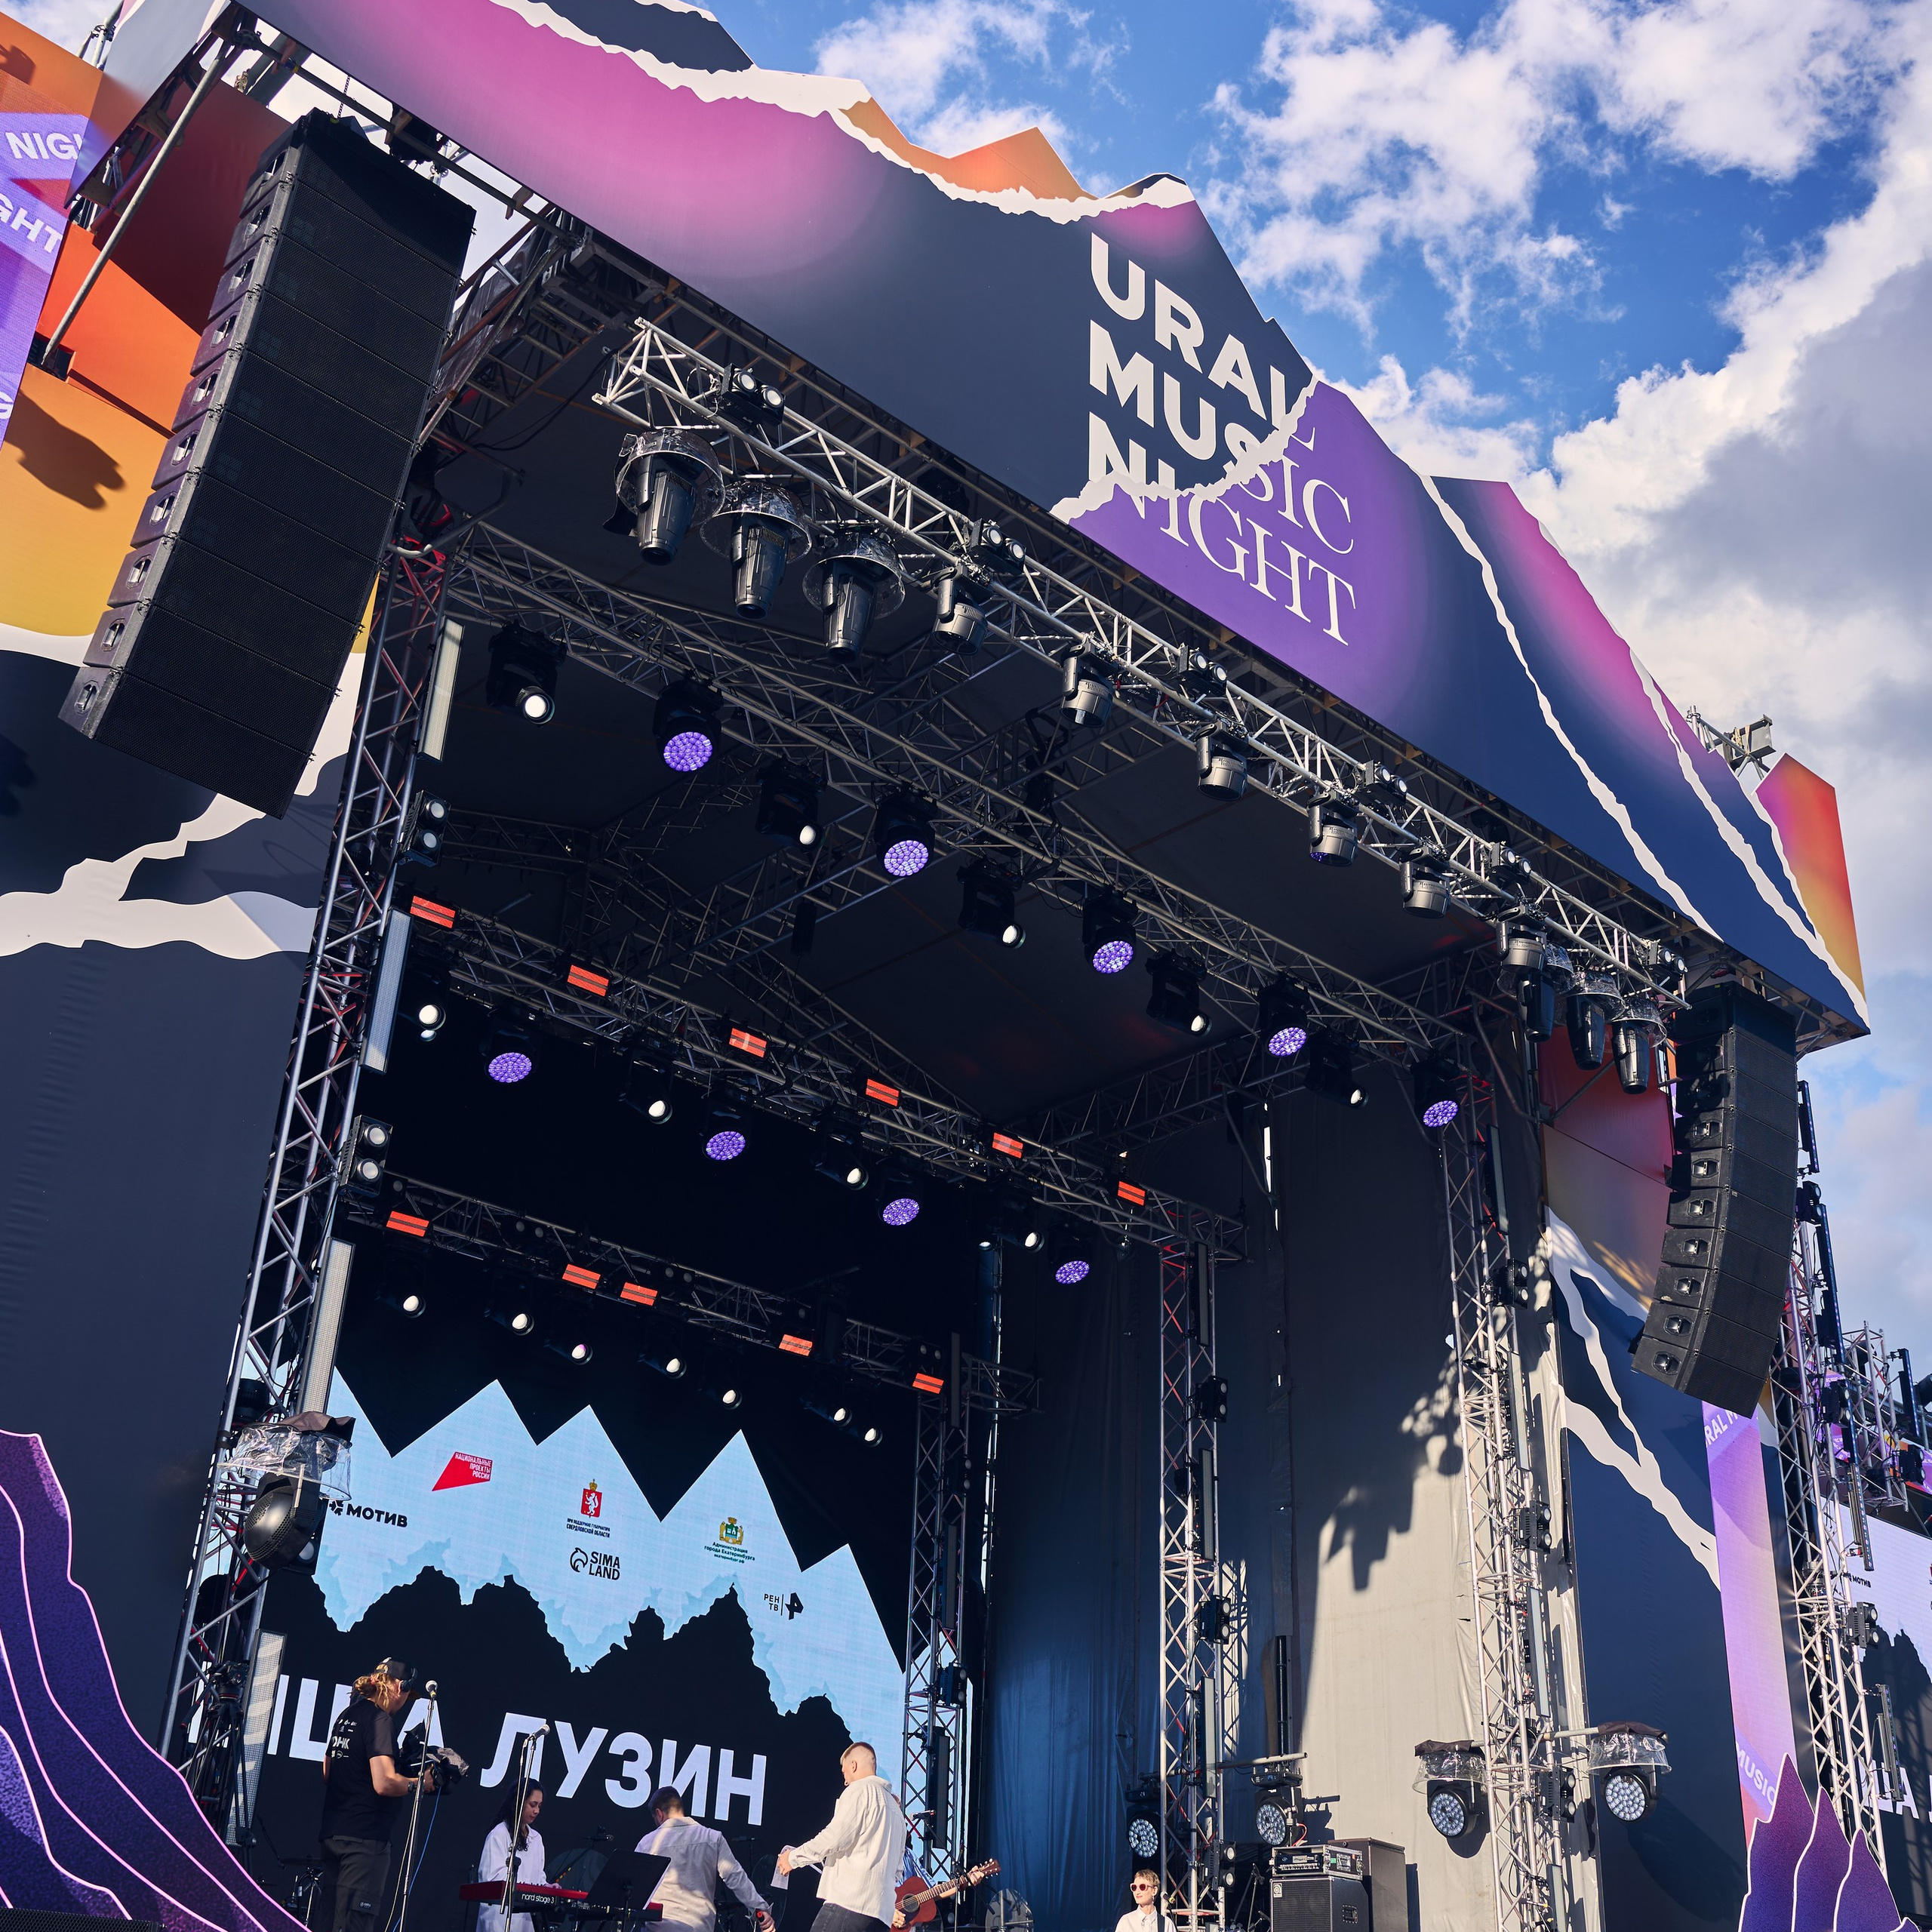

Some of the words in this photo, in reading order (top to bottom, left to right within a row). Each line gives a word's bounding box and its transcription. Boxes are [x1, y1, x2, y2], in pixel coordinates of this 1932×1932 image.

[1091, 232, 1316, 451] URAL
[1089, 318, 1355, 555] MUSIC
[1088, 411, 1356, 647] NIGHT
[1704, 1414, 1728, 1448] RAL
[469, 1463, 491, 1474] ПРОЕКТЫ
[472, 1470, 491, 1480] РОССИИ
[346, 1503, 408, 1527] МОТИВ
[589, 1551, 620, 1569] SIMA
[589, 1563, 620, 1581] LAND
[764, 1593, 780, 1604] РЕН
[768, 1602, 779, 1611] ТВ
[479, 1712, 768, 1826] ЛУЗИН
[521, 1894, 535, 1902] nord
